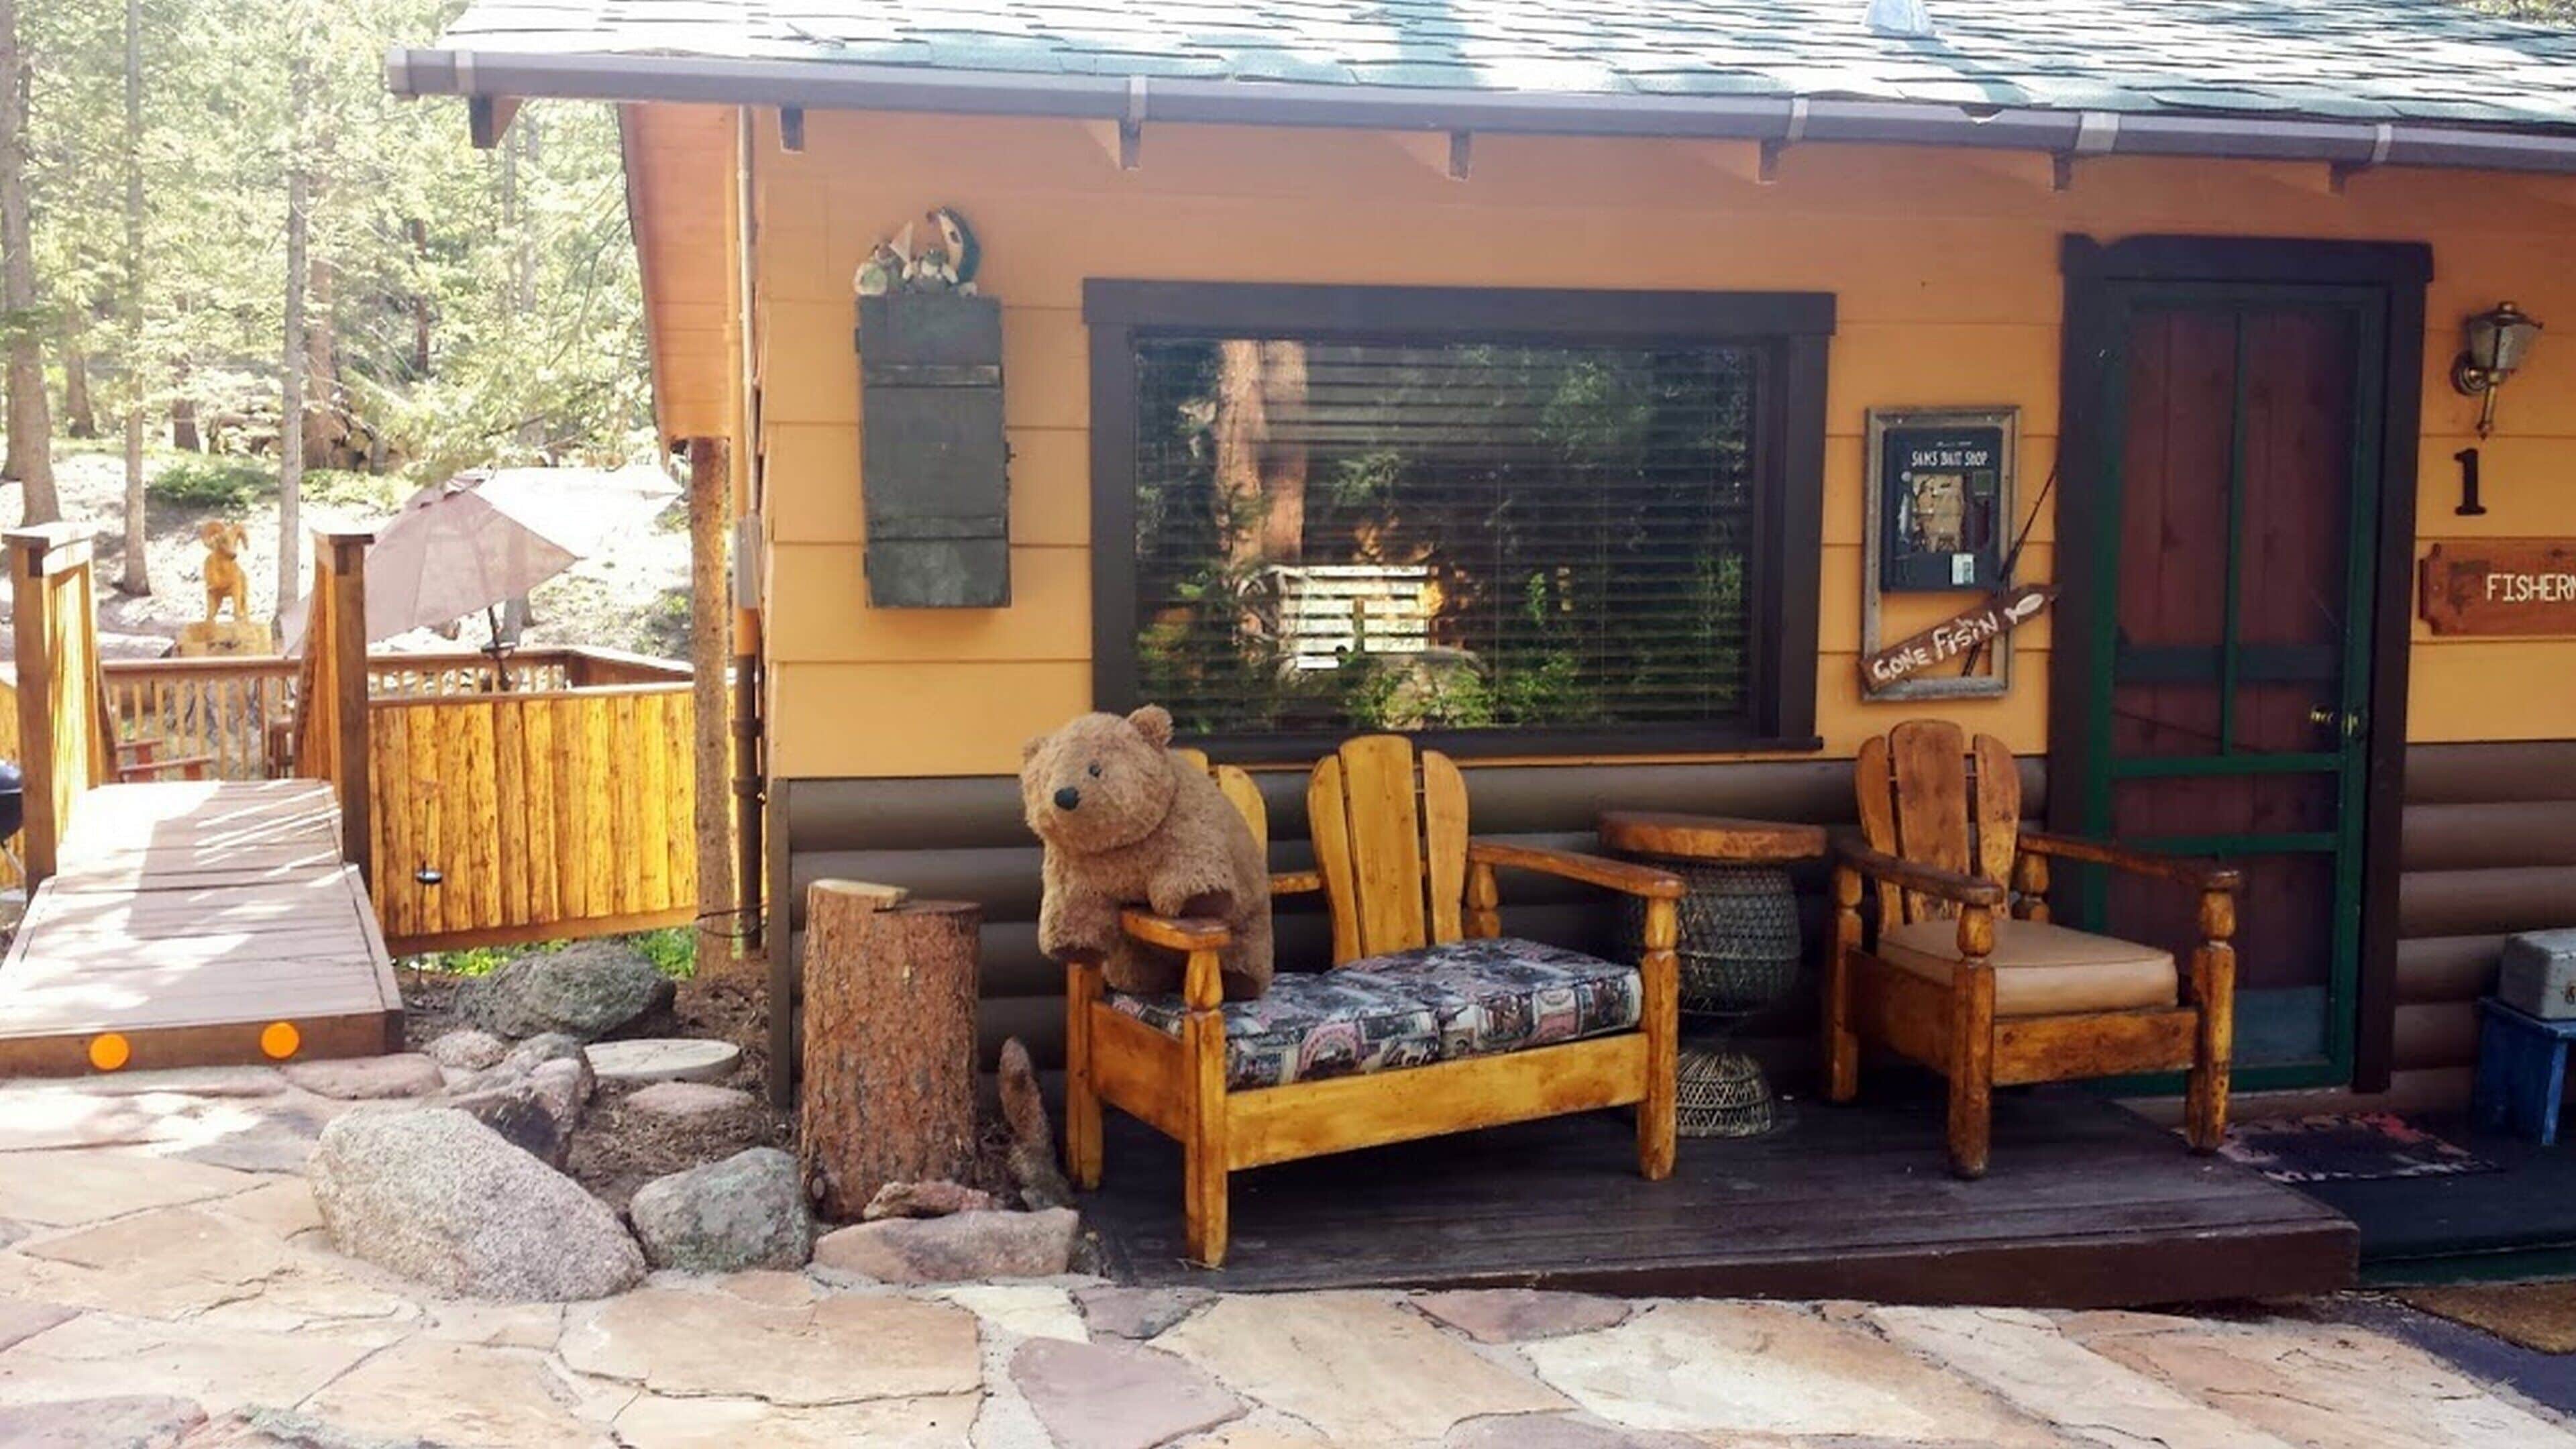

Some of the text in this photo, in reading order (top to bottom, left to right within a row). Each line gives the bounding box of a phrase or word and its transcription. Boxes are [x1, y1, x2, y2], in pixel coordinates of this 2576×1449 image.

[1965, 450, 1988, 466] SHOP
[2454, 447, 2487, 516] 1
[1872, 647, 1931, 680] GONE
